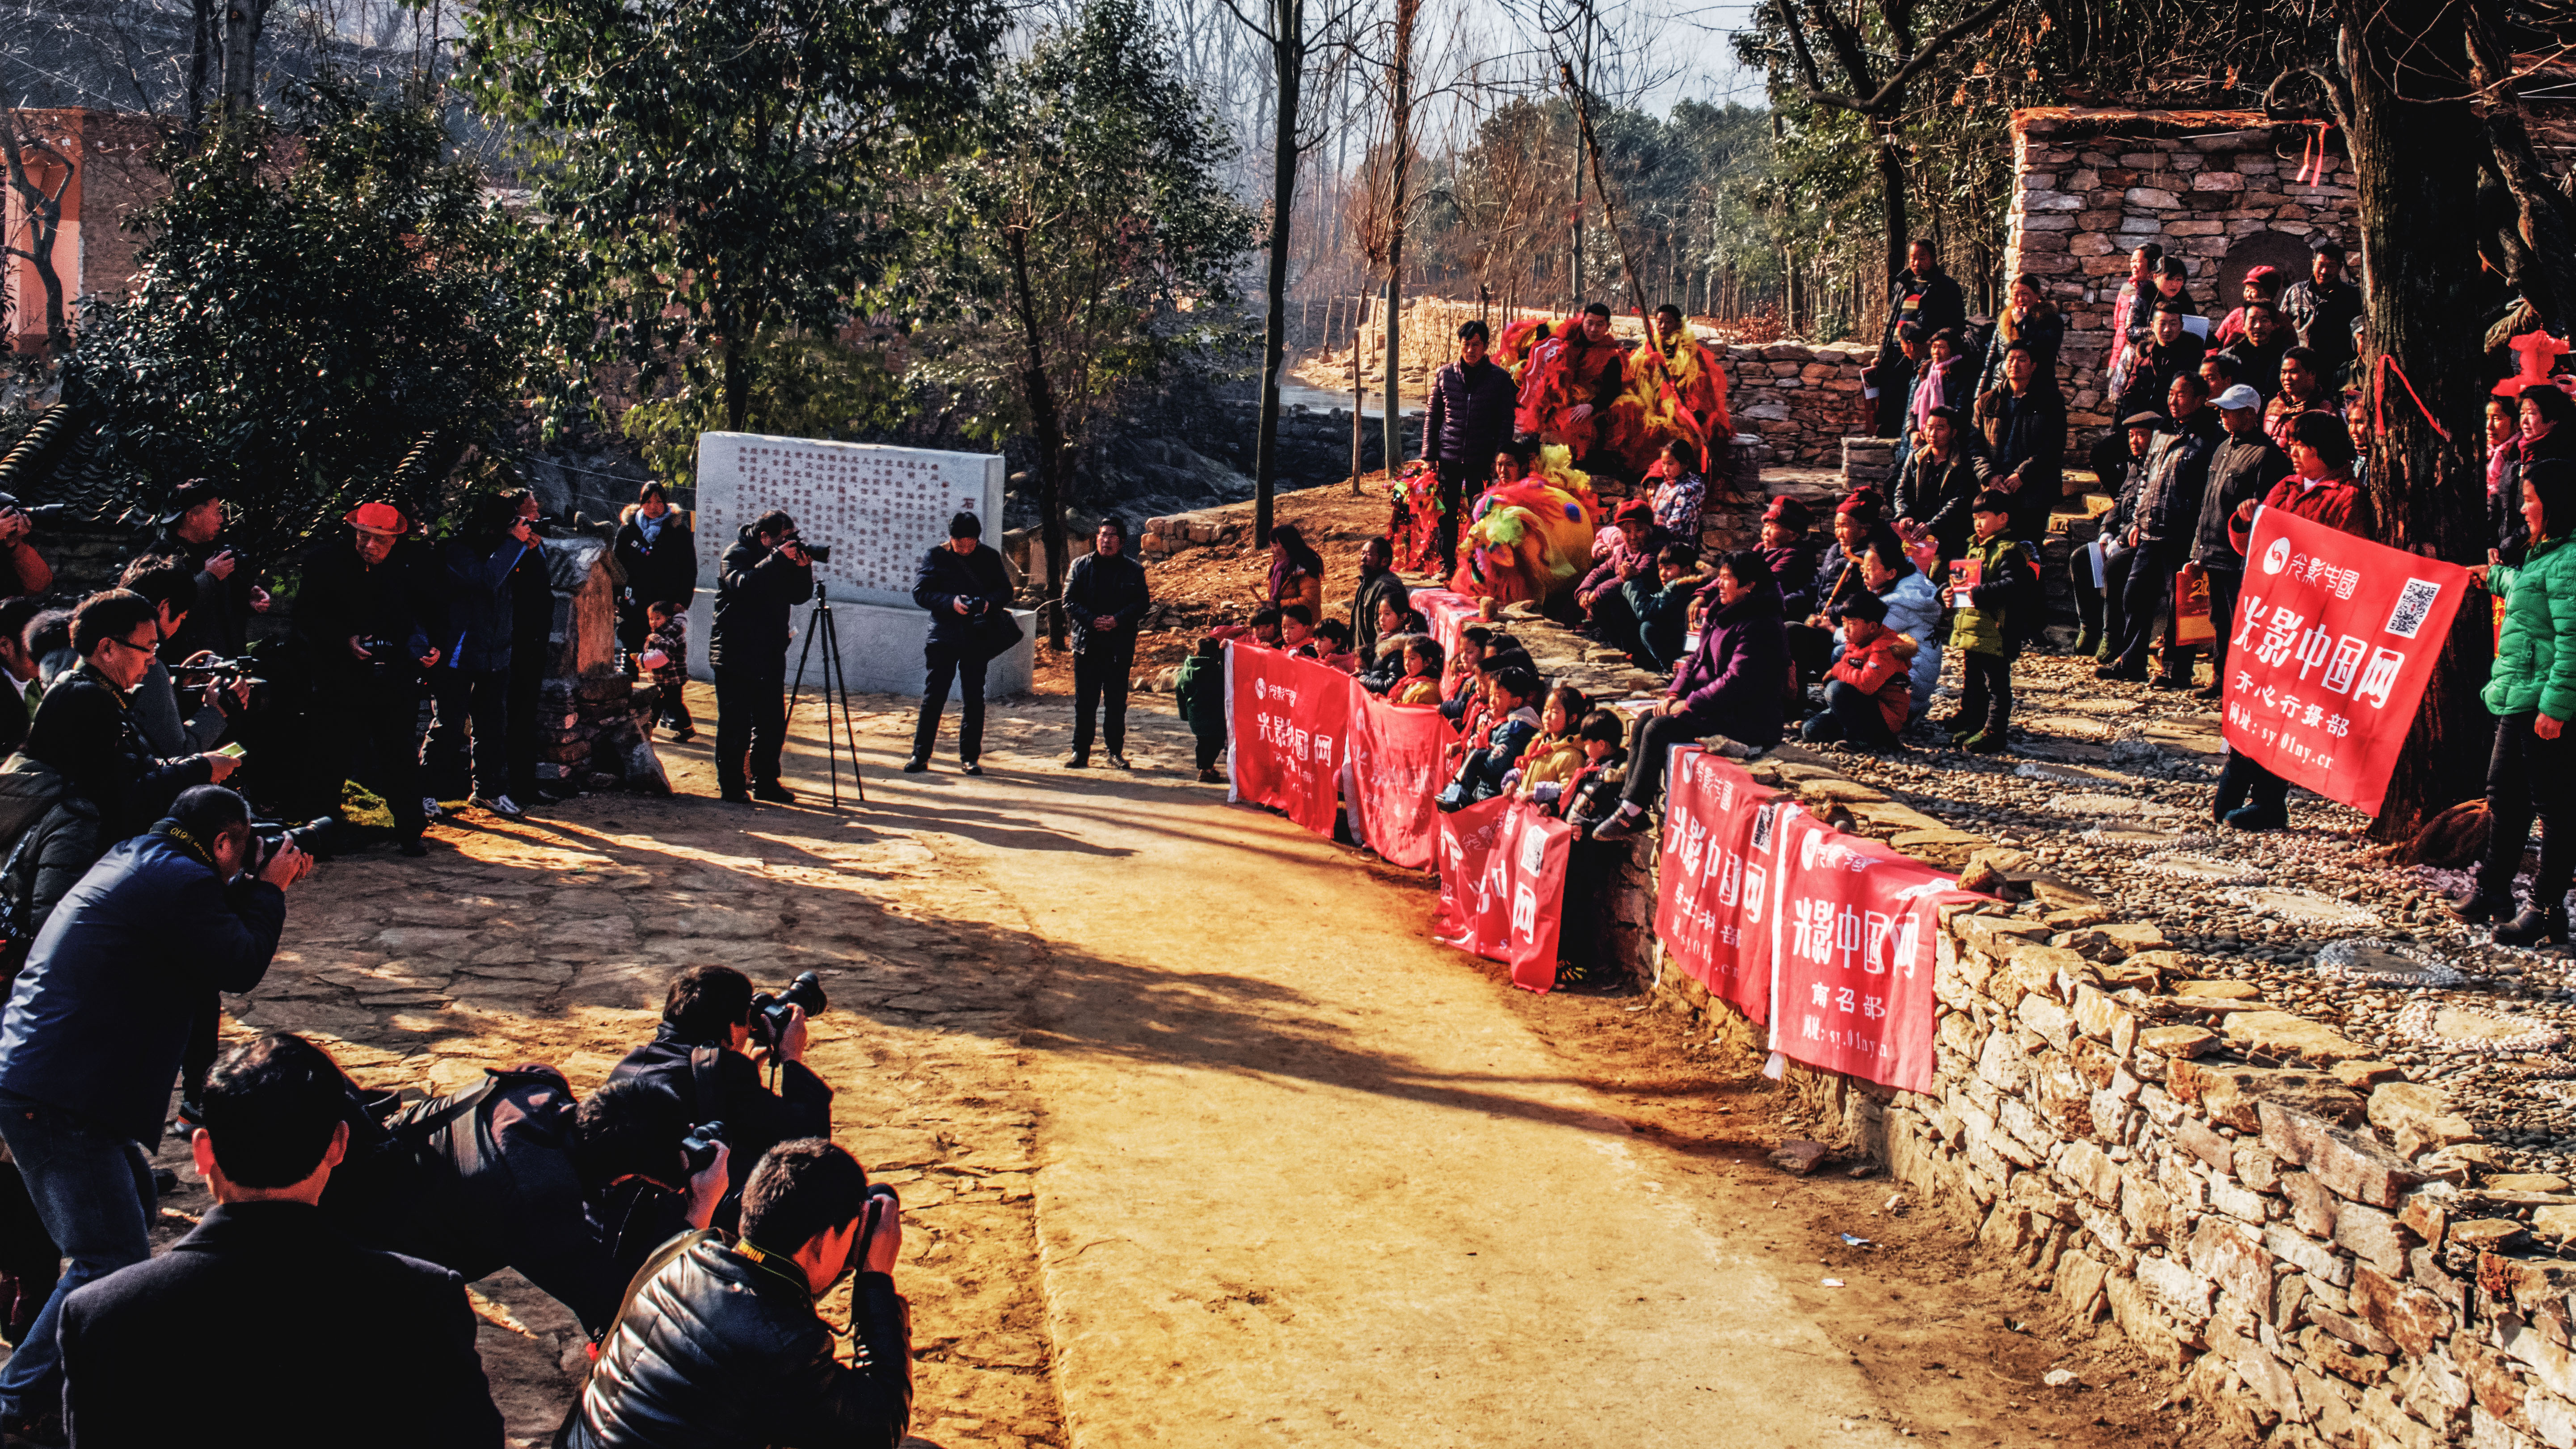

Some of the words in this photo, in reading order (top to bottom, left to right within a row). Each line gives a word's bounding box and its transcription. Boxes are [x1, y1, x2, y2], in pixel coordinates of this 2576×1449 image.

[2233, 596, 2405, 709] 光影中国网
[2235, 670, 2350, 739] 开心行摄部
[1667, 806, 1767, 923] 光影中国网
[1793, 897, 1919, 979] 光影中国网
[1811, 981, 1885, 1020] 南召部
[738, 1242, 766, 1263] Nikon
